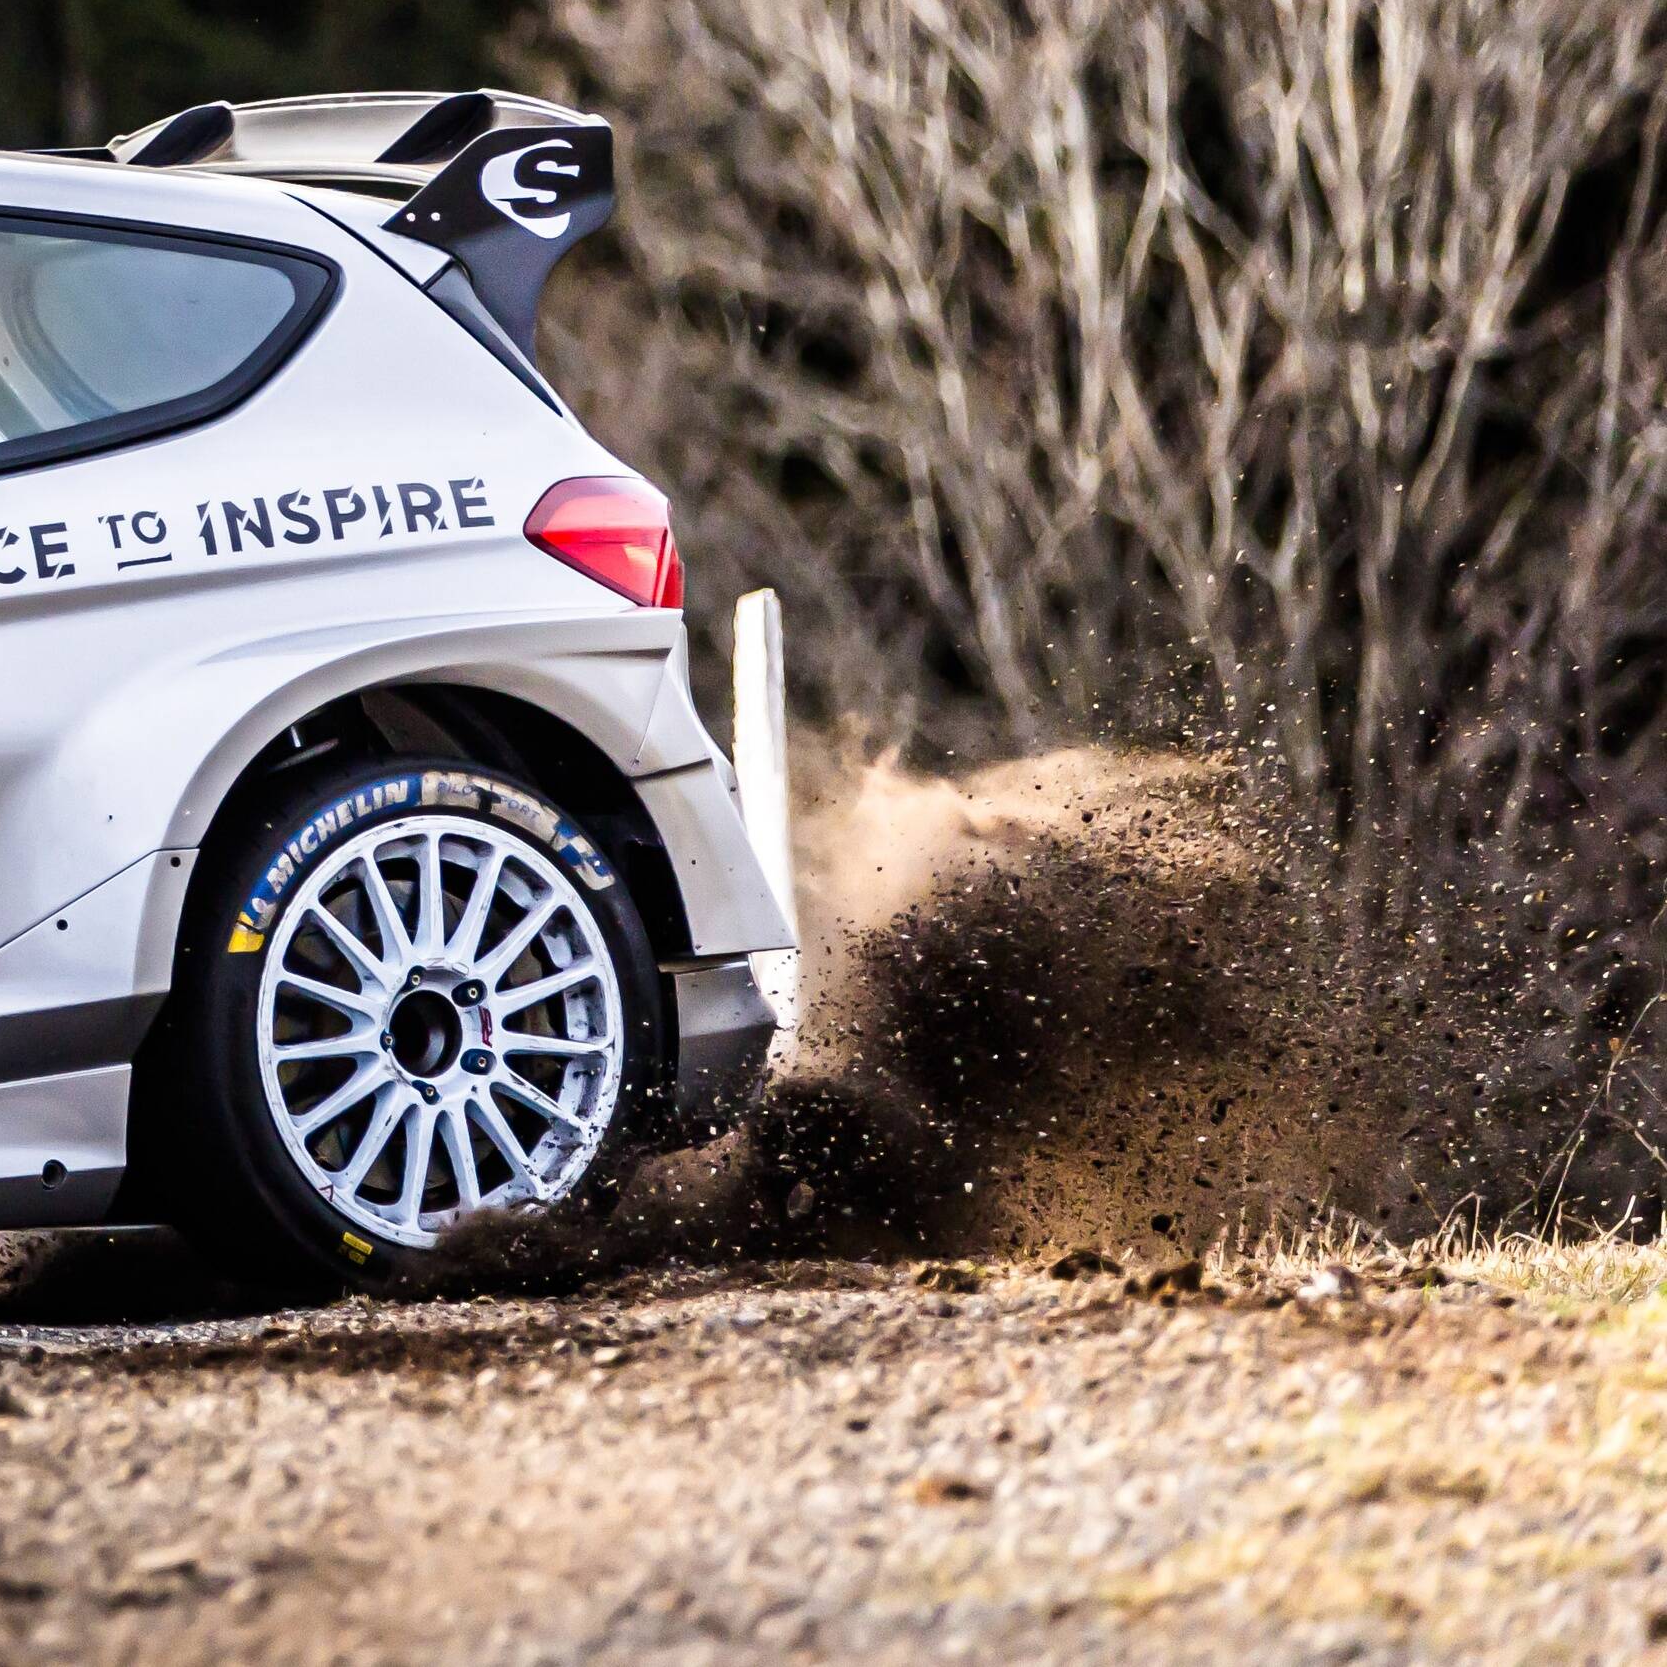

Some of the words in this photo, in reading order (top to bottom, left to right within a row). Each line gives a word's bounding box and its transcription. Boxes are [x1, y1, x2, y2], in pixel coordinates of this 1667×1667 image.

[98, 510, 167, 550] TO
[195, 476, 496, 557] INSPIRE
[266, 780, 408, 894] MICHELIN
